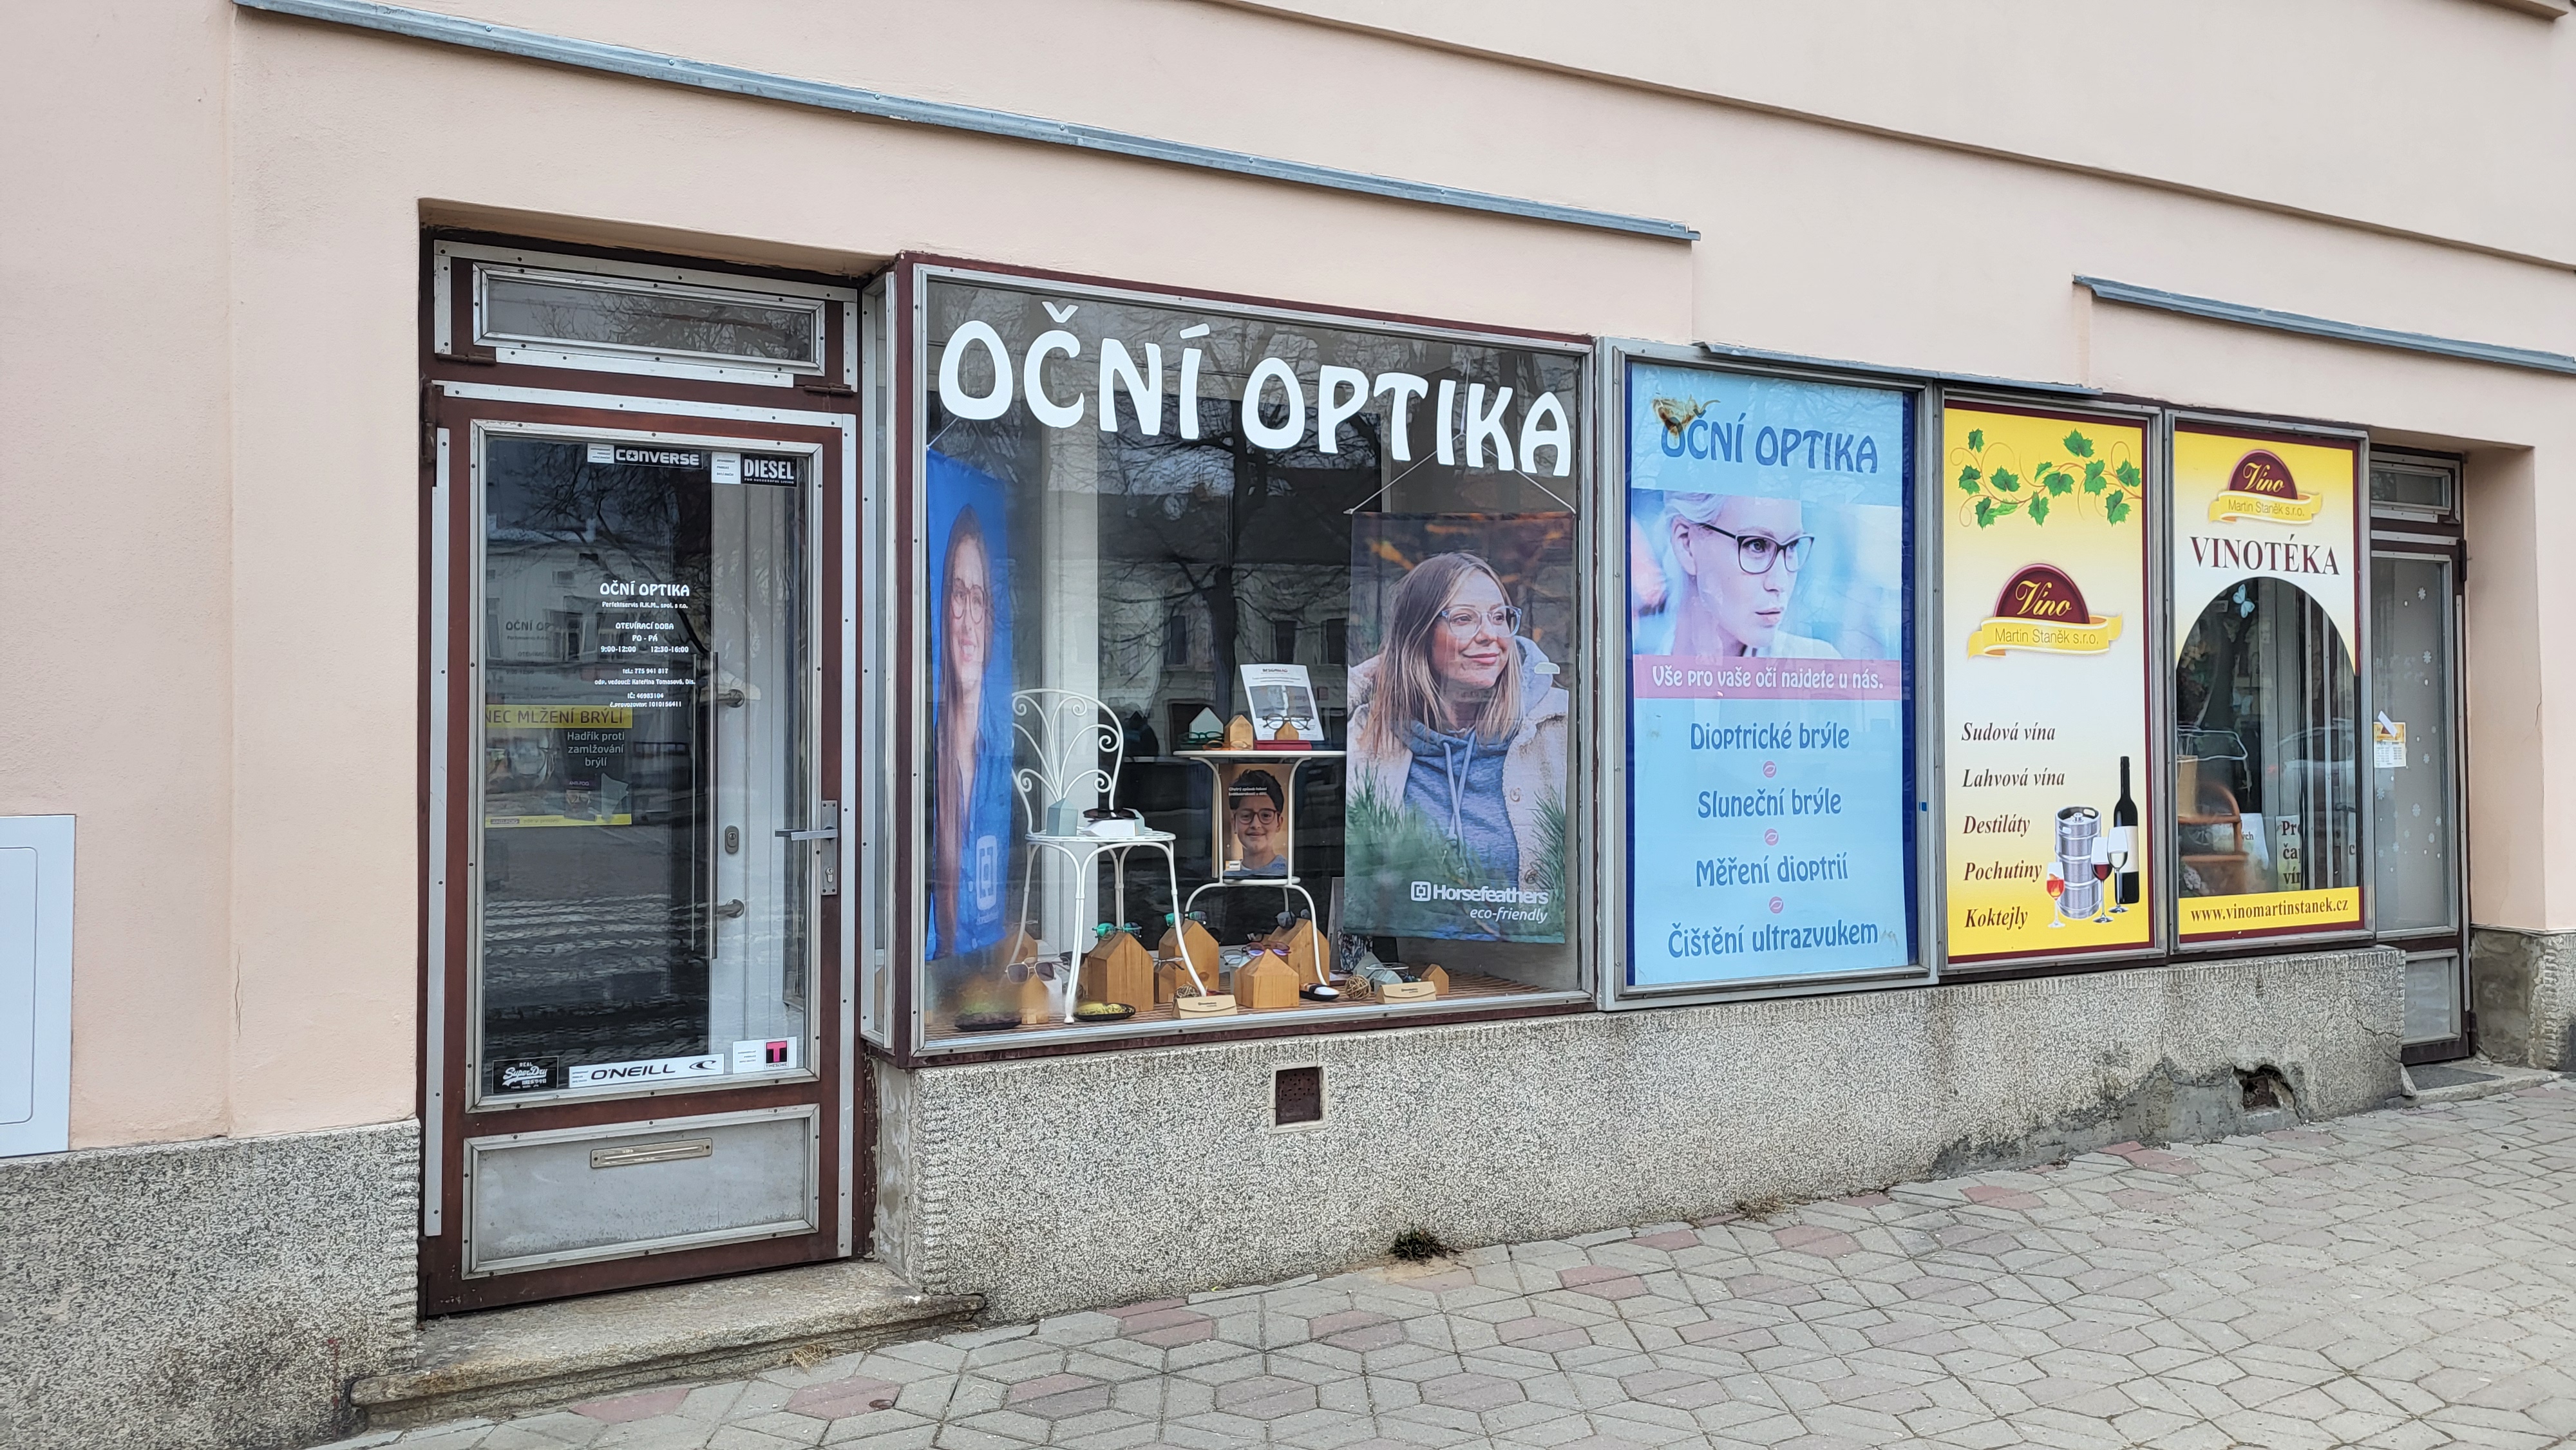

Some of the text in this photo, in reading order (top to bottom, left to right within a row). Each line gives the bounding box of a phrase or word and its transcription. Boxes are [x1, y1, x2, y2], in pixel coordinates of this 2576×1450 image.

[939, 301, 1572, 477] OČNÍ OPTIKA
[1661, 409, 1878, 474] OČNÍ OPTIKA
[616, 449, 699, 466] CONVERSE
[744, 458, 795, 480] DIESEL
[2228, 499, 2305, 516] Martin Staněk s.r.o.
[2190, 534, 2340, 576] VINOTÉKA
[600, 580, 690, 597] OČNÍ OPTIKA
[615, 621, 654, 630] OTEVÍRACÍ
[648, 634, 658, 642] PÁ
[1995, 628, 2099, 645] Martin Staněk s.r.o.
[1652, 665, 1884, 689] Vše pro vaše oči najdete u nás.
[518, 708, 574, 724] MLŽENÍ
[580, 707, 623, 724] BRÝLÍ
[567, 731, 625, 742] Hadřík proti
[1690, 720, 1850, 750] Dioptrické brýle
[1961, 722, 2056, 742] Sudová vína
[567, 744, 624, 753] zamlžování
[585, 757, 607, 768] brýlí
[1962, 767, 2066, 788] Lahvová vína
[1698, 787, 1842, 819] Sluneční brýle
[1963, 814, 2031, 837] Destiláty
[1696, 852, 1848, 887] Měření dioptrií
[1964, 860, 2043, 882] Pochutiny
[1433, 884, 1549, 905] Horsefeathers
[1470, 907, 1548, 924] eco-friendly
[1964, 906, 2029, 930] Koktejly
[2190, 896, 2349, 923] www.vinomartinstanek.cz
[1668, 919, 1879, 958] Čištění ultrazvukem
[591, 1064, 676, 1080] O'NEILL
